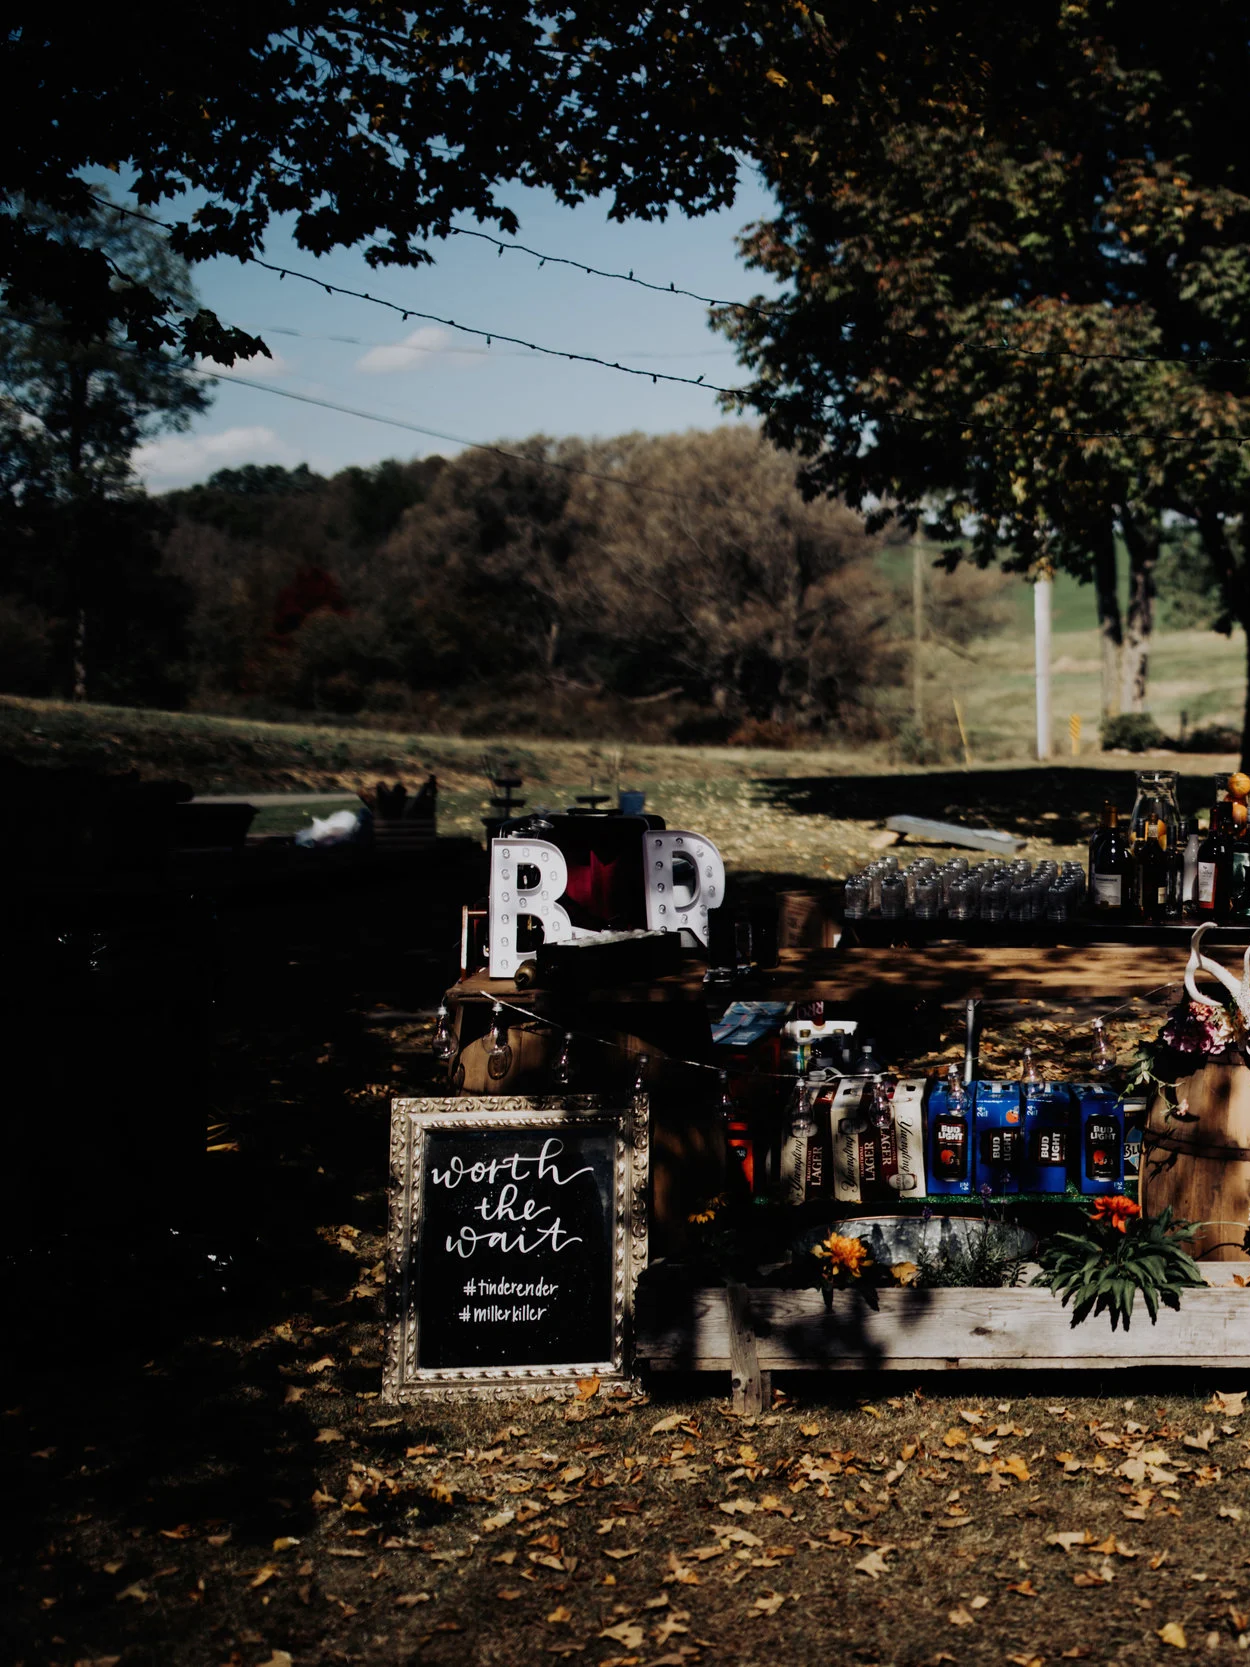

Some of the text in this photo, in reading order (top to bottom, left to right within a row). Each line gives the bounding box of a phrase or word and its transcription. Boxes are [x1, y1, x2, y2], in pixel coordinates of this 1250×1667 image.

[489, 837, 573, 979] B
[897, 1115, 913, 1173] Yuengling
[938, 1132, 964, 1141] LIGHT
[941, 1125, 961, 1134] BUD
[1090, 1132, 1117, 1141] LIGHT
[1093, 1125, 1114, 1134] BUD
[880, 1126, 893, 1166] LAGER
[992, 1136, 1001, 1159] BUD
[1003, 1132, 1012, 1161] LIGHT
[1040, 1136, 1050, 1159] BUD
[1051, 1132, 1061, 1161] LIGHT
[431, 1137, 595, 1189] worth
[810, 1146, 823, 1187] LAGER
[841, 1136, 858, 1193] Yuengling
[865, 1141, 877, 1182] LAGER
[473, 1183, 552, 1221] the
[446, 1217, 583, 1259] wait
[462, 1276, 559, 1297] #tinderender
[458, 1304, 548, 1323] #millerkiller
